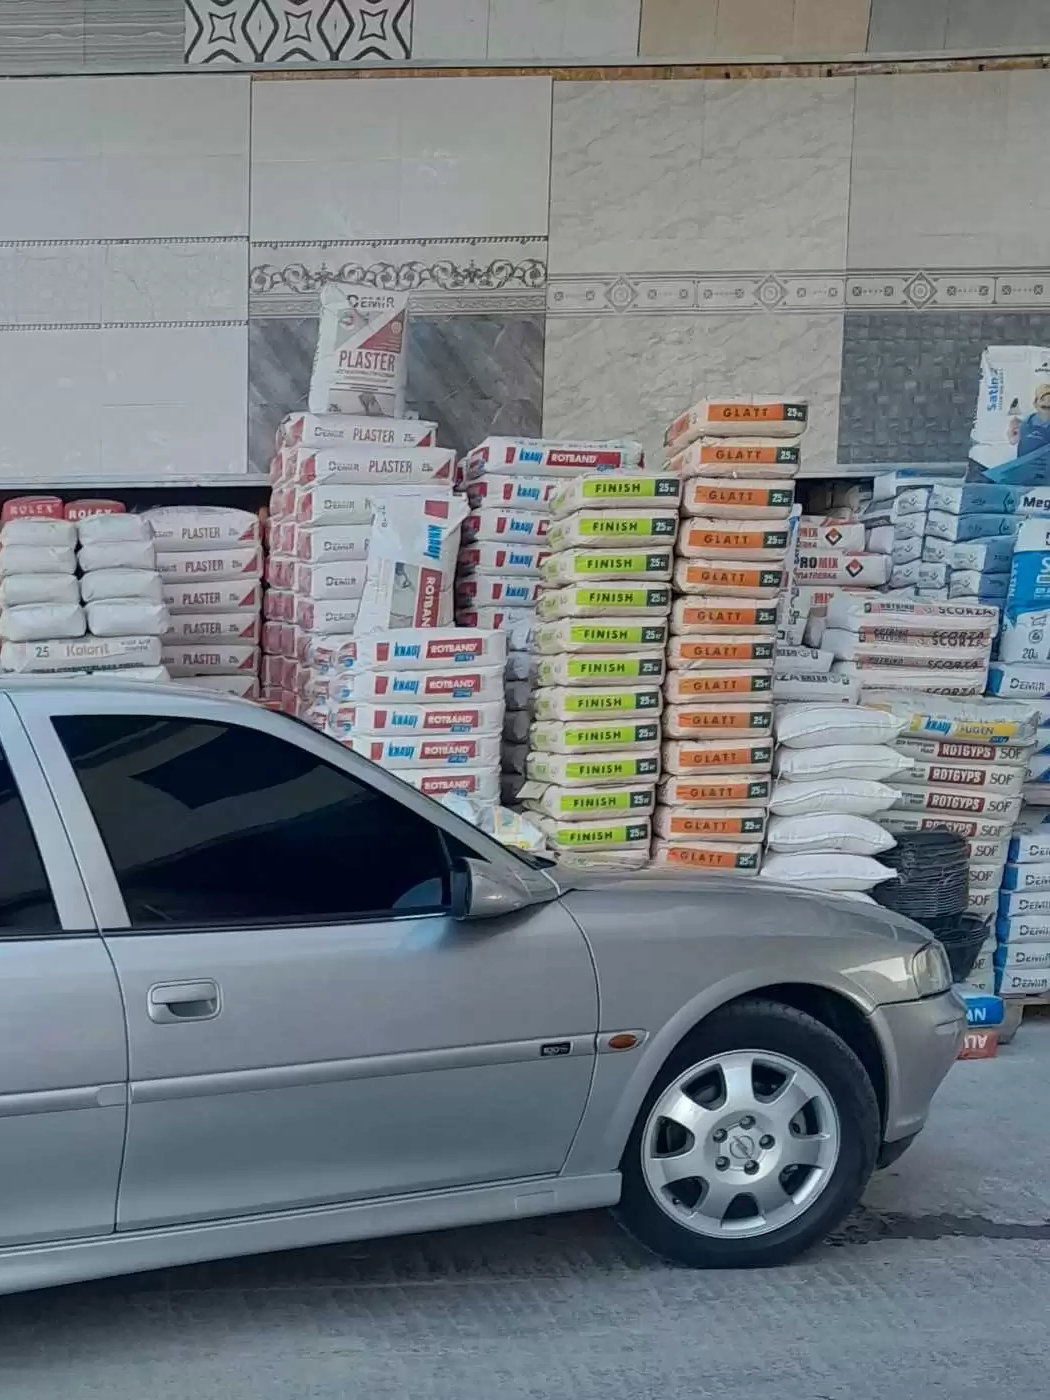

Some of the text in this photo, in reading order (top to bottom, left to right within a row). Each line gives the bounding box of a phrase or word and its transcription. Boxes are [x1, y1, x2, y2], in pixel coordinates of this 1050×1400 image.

[338, 350, 396, 372] PLASTER
[723, 408, 768, 418] GLATT
[353, 428, 395, 443] PLASTER
[551, 452, 597, 464] ROTBAND
[716, 450, 762, 459] GLATT
[369, 460, 413, 474] PLASTER
[594, 483, 641, 493] FINISH
[708, 491, 754, 501] GLATT
[592, 521, 638, 532] FINISH
[182, 527, 221, 540] PLASTER
[704, 535, 749, 545] GLATT
[185, 559, 224, 573] PLASTER
[587, 558, 633, 569] FINISH
[701, 571, 747, 582] GLATT
[182, 592, 221, 605] PLASTER
[589, 592, 634, 602] FINISH
[697, 611, 742, 621] GLATT
[183, 622, 222, 635] PLASTER
[584, 628, 628, 640] FINISH
[35, 646, 50, 658] 25
[430, 643, 478, 654] ROTBAND
[694, 646, 738, 656] GLATT
[182, 653, 221, 666] PLASTER
[581, 662, 626, 674] FINISH
[429, 679, 475, 690] ROTBAND
[693, 680, 737, 691] GLATT
[578, 697, 622, 708] FINISH
[427, 715, 473, 725] ROTBAND
[692, 715, 737, 725] GLATT
[578, 730, 622, 741] FINISH
[424, 746, 470, 756] ROTBAND
[941, 745, 991, 758] ROTGYPS
[999, 748, 1022, 759] SOF
[694, 752, 738, 763] GLATT
[579, 763, 623, 775] FINISH
[932, 768, 982, 783] ROTGYPS
[990, 774, 1015, 785] SOF
[424, 779, 471, 791] ROTBAND
[690, 787, 733, 797] GLATT
[573, 796, 617, 808] FINISH
[931, 795, 980, 810] ROTGYPS
[988, 801, 1012, 813] SOF
[684, 821, 727, 831] GLATT
[570, 830, 613, 842] FINISH
[974, 845, 999, 856] SOF
[680, 851, 723, 864] GLATT
